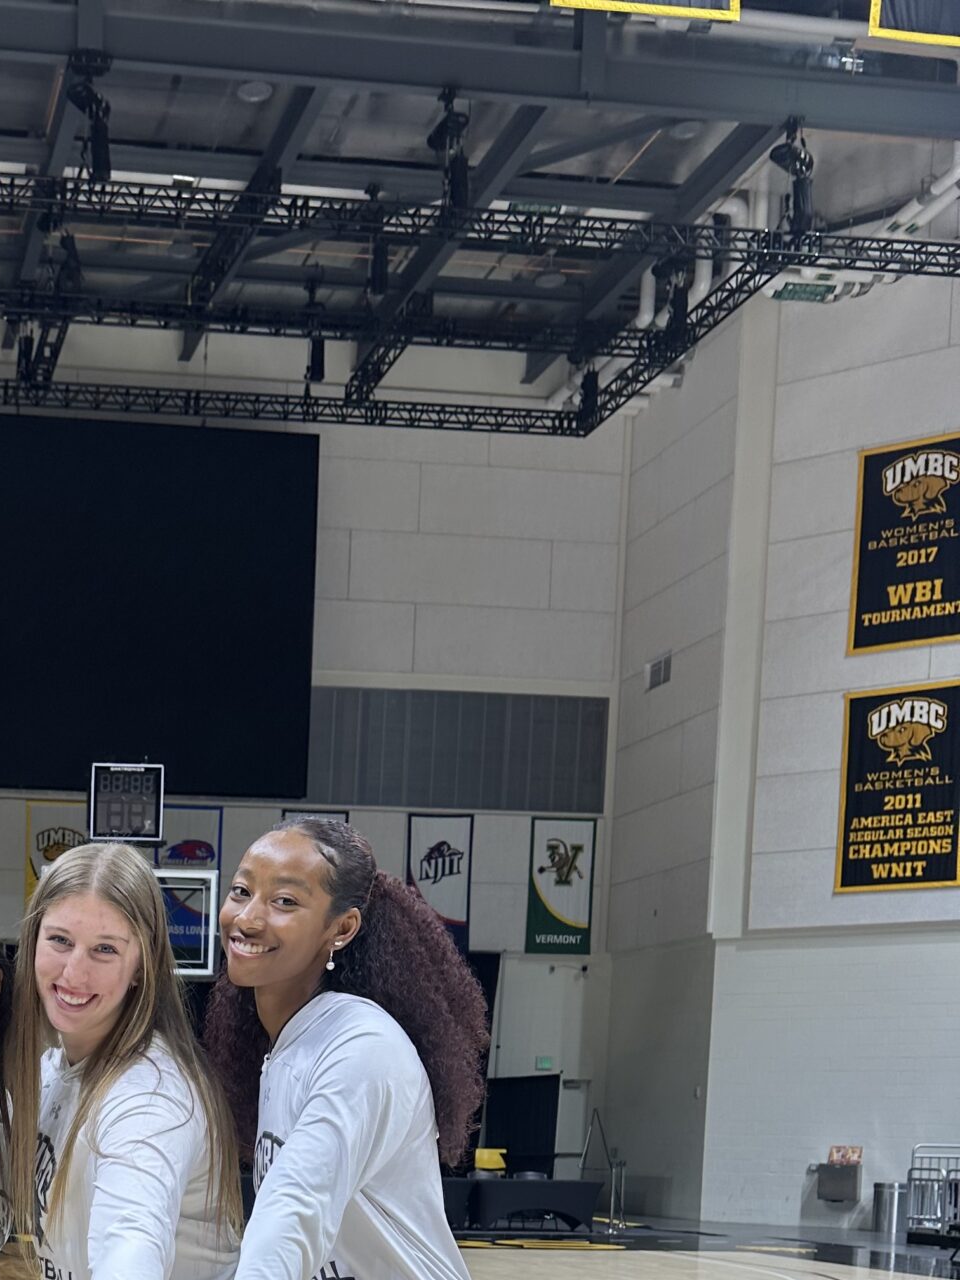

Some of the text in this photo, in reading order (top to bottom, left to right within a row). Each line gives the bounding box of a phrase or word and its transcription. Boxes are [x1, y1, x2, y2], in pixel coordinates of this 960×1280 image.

[885, 453, 959, 493] UMBC
[881, 519, 955, 538] WOMEN'S
[868, 529, 959, 550] BASKETBAL
[896, 547, 938, 567] 2017
[887, 579, 943, 607] WBI
[871, 700, 945, 737] UMBC
[855, 775, 953, 792] BASKETBALL
[867, 767, 940, 781] WOMEN'S
[884, 793, 922, 811] 2011
[851, 810, 954, 830] AMERICA EAST
[849, 824, 954, 843] REGULAR SEASON
[848, 838, 952, 860] CHAMPIONS
[871, 860, 927, 879] WNIT
[536, 933, 582, 945] VERMONT
